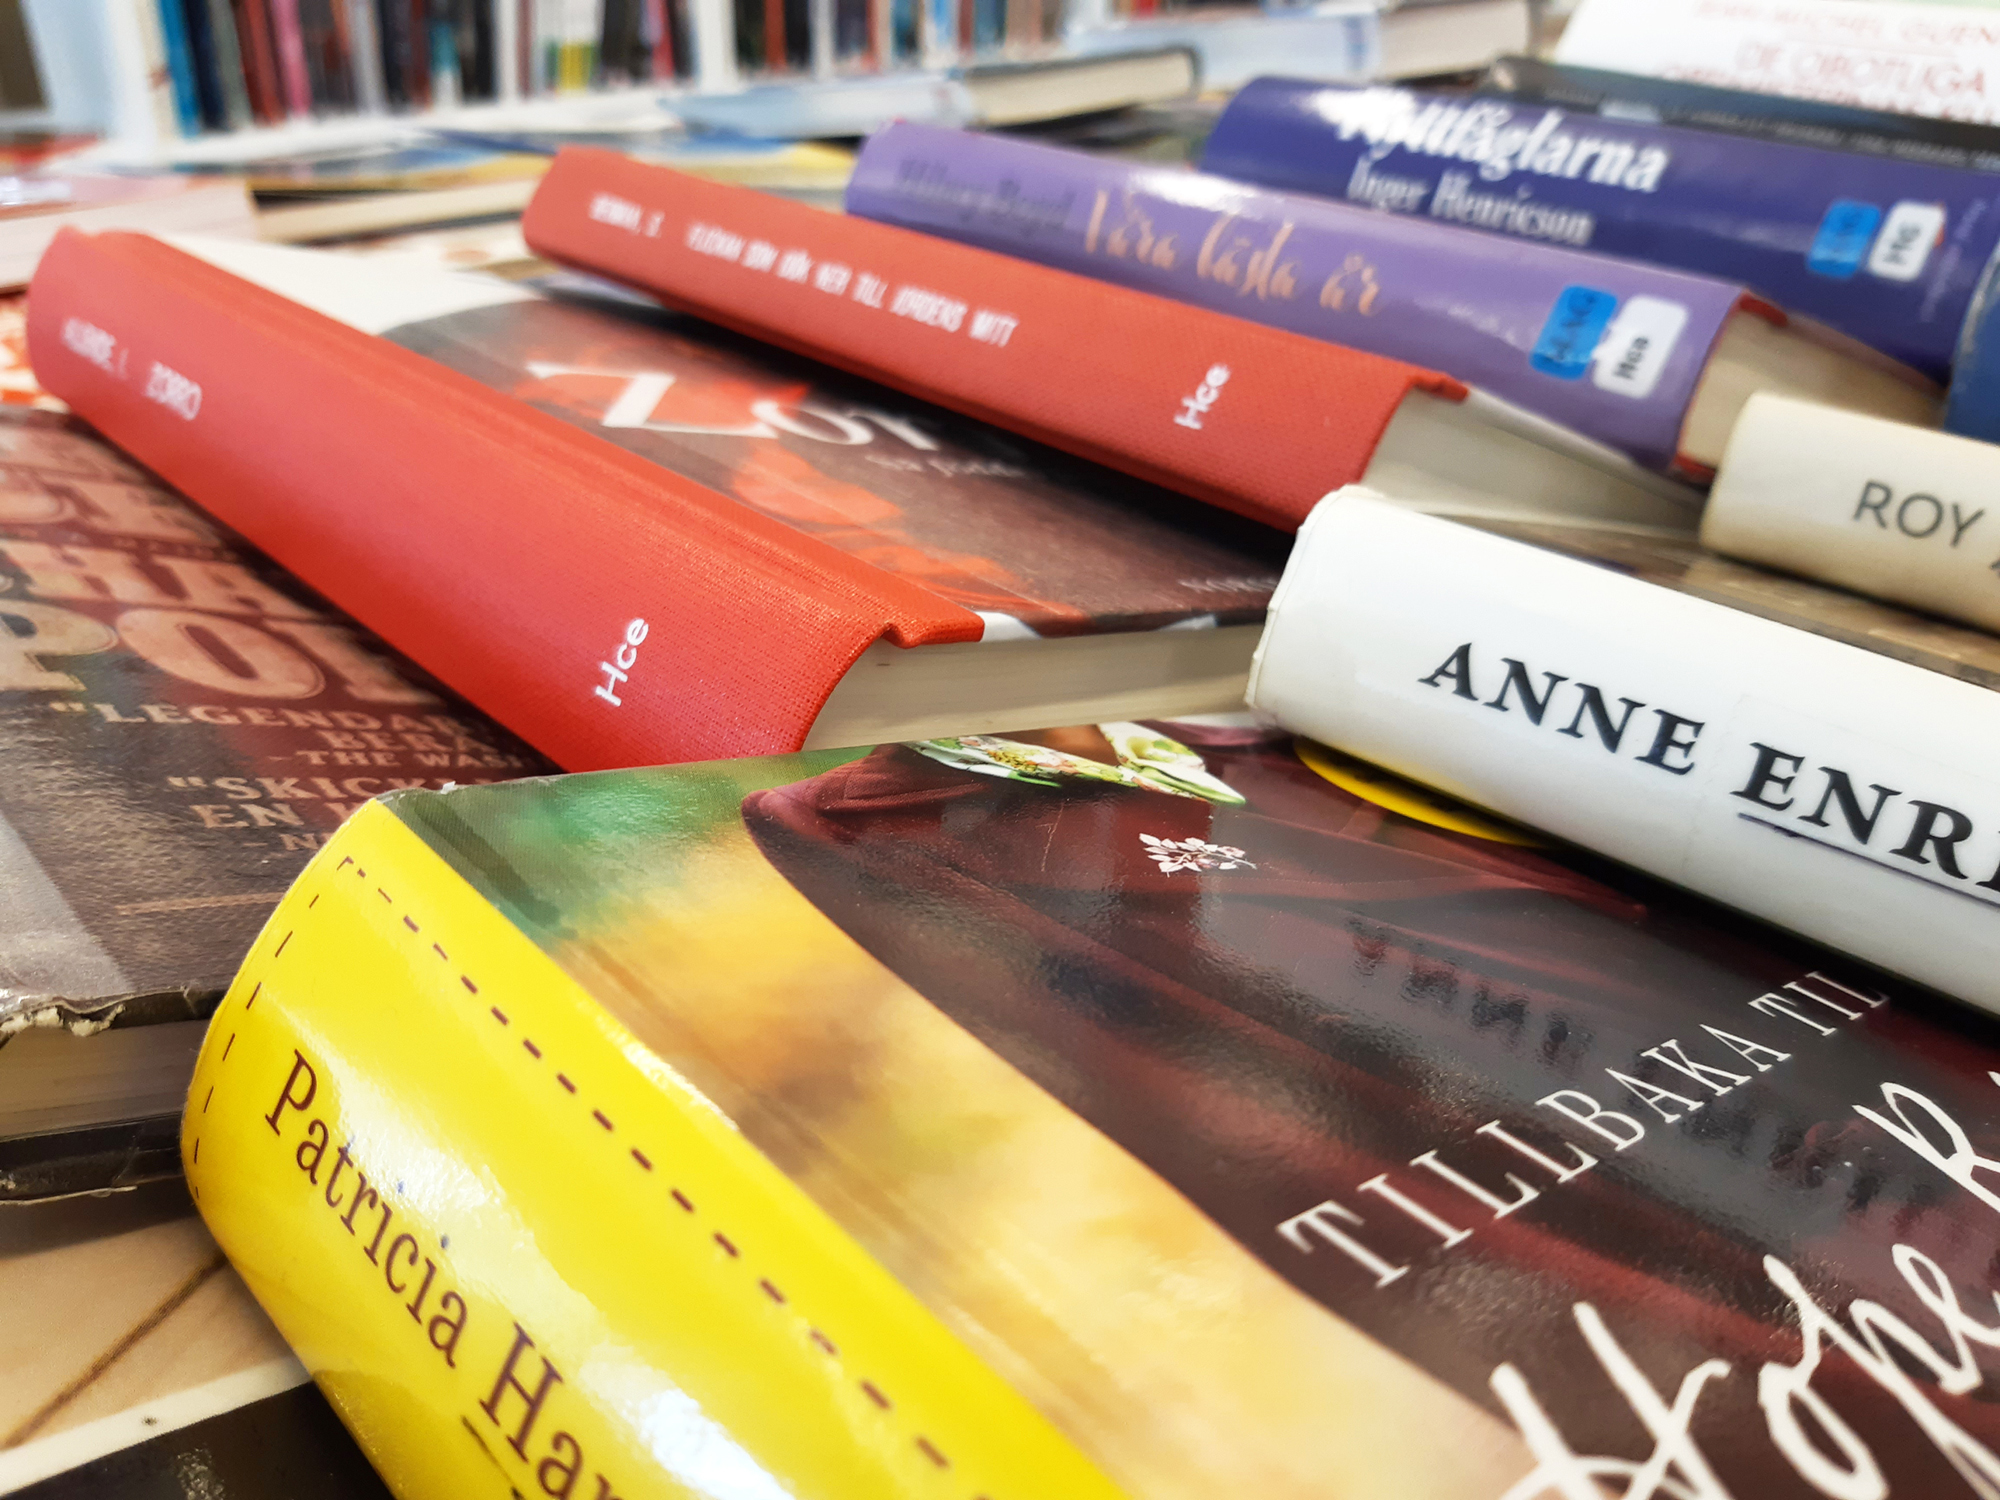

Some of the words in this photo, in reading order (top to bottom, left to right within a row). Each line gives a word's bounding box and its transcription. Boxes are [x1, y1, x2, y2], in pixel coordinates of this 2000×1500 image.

[1346, 153, 1430, 214] Inger
[1173, 363, 1231, 430] Hce
[1852, 478, 1986, 547] ROY
[595, 617, 650, 707] Hce
[1417, 642, 1706, 776] ANNE
[188, 803, 304, 828] EN
[1275, 1020, 1794, 1291] TILLBAKA
[263, 1048, 470, 1370] Patricia
